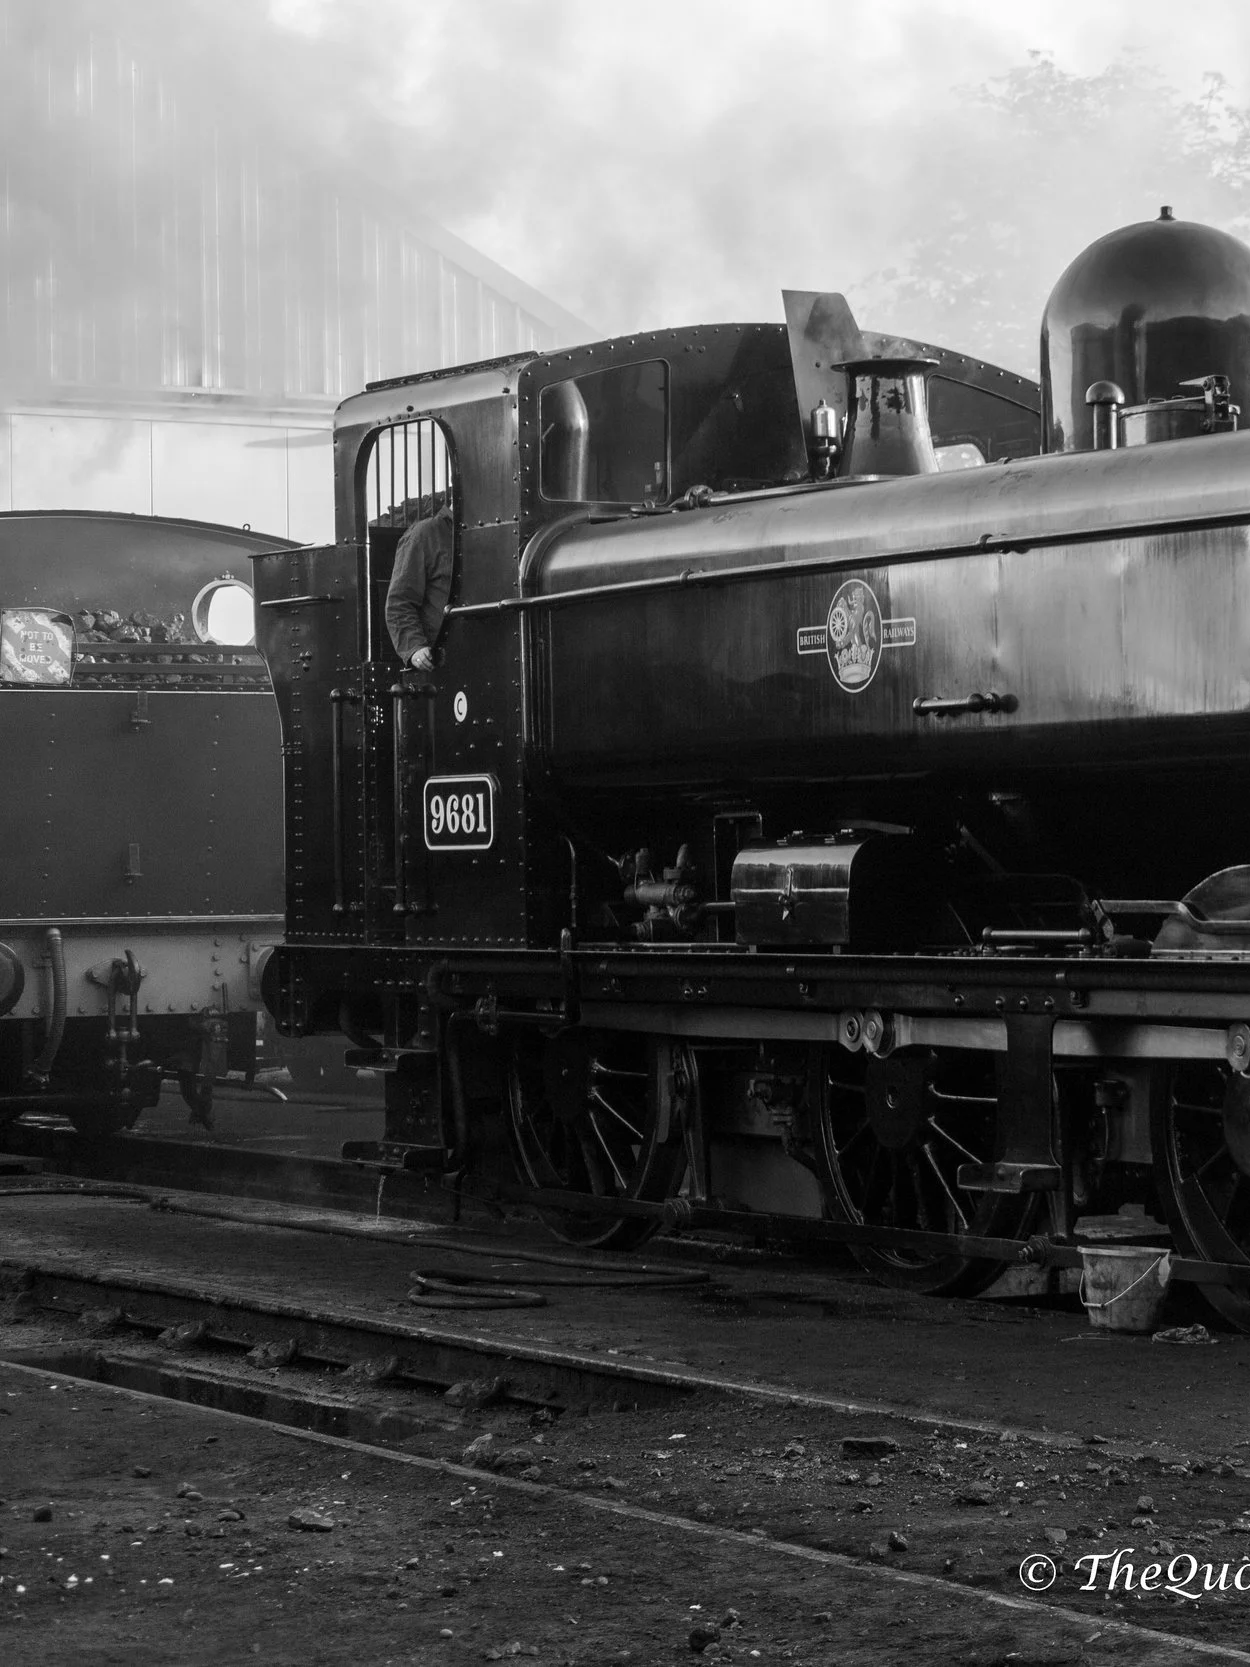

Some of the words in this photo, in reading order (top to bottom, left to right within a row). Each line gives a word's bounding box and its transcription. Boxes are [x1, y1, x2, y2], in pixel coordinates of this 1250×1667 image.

[20, 630, 40, 641] NOT
[42, 631, 54, 641] TO
[799, 633, 826, 646] BRITISH
[883, 625, 915, 640] RAILWAYS
[29, 642, 43, 652] BE
[20, 653, 53, 665] MOVED
[430, 793, 487, 834] 9681
